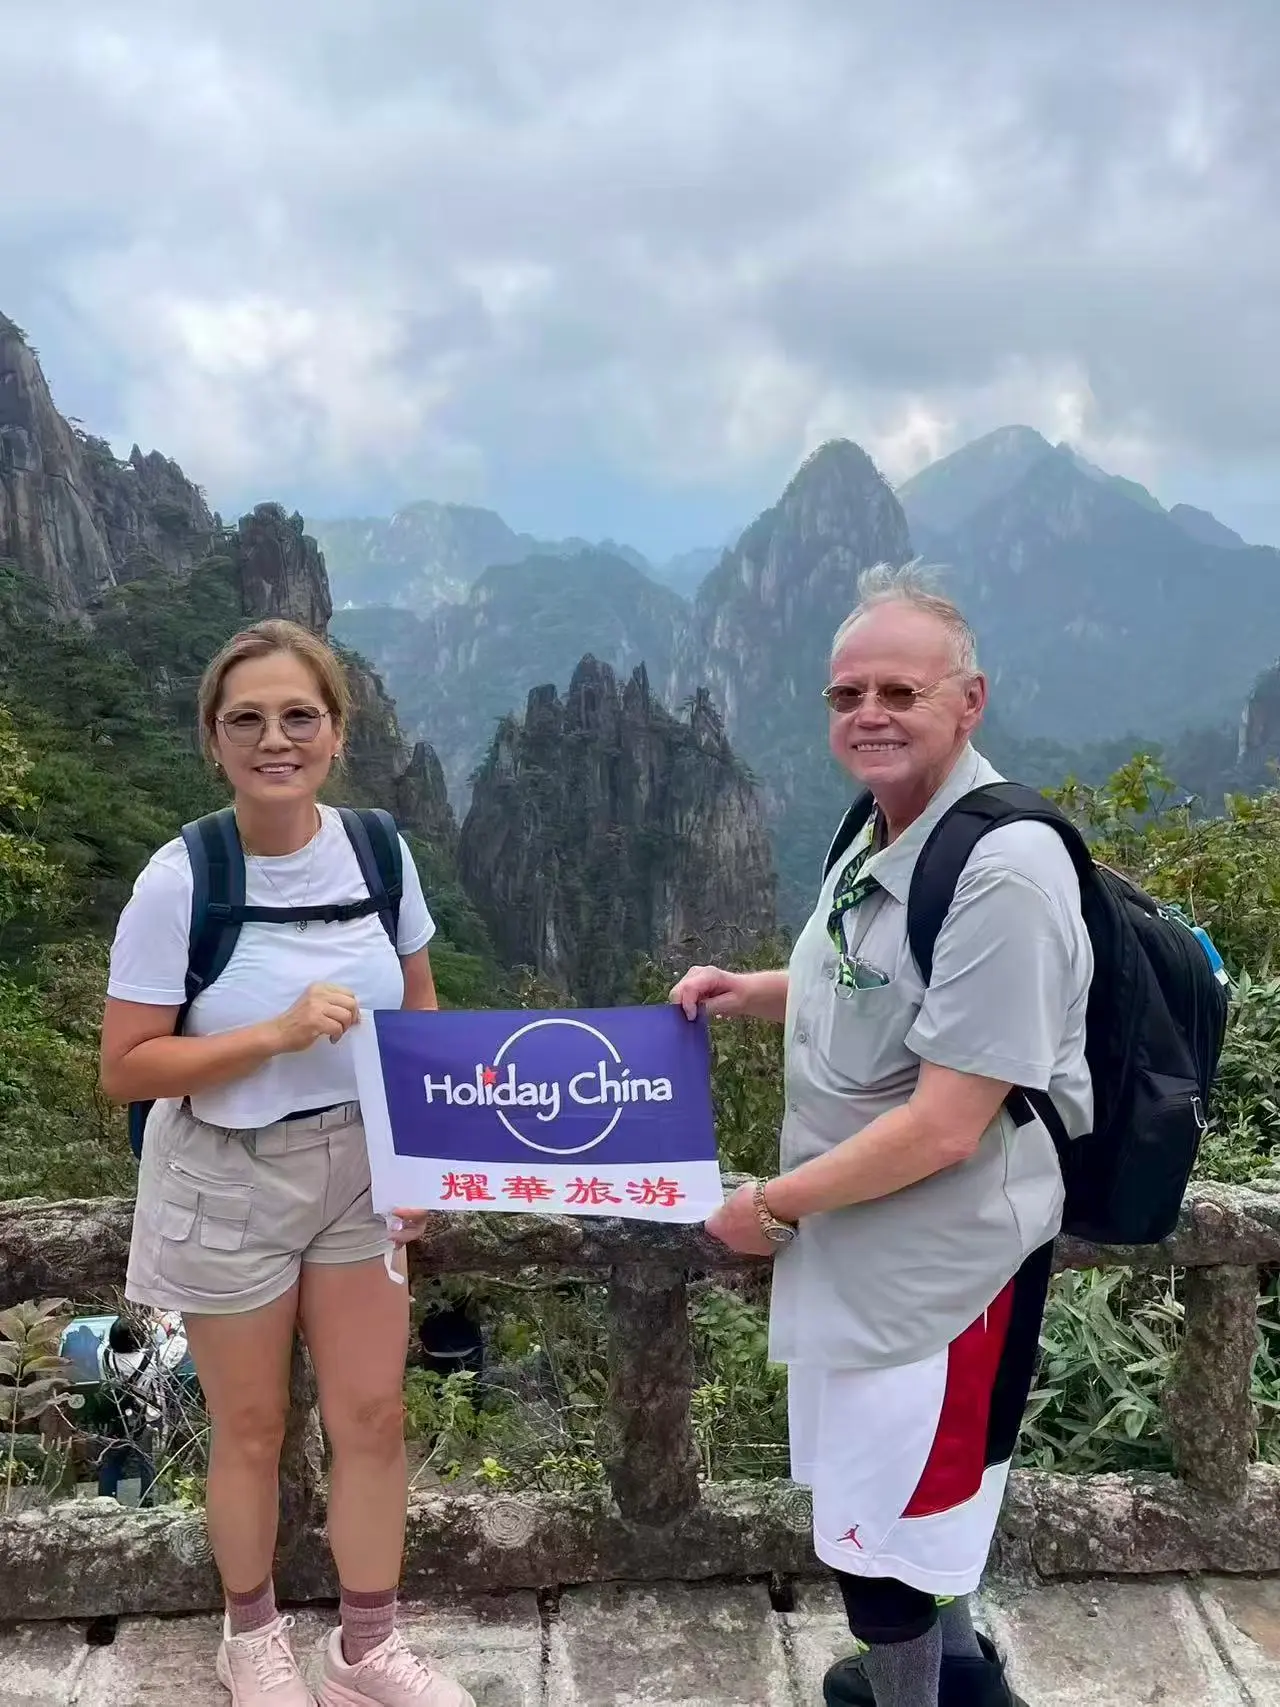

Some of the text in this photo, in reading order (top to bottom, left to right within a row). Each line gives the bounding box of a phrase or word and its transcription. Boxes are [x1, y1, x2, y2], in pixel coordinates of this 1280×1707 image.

[423, 1060, 673, 1122] Holiday China
[439, 1171, 687, 1207] 耀華旅游
